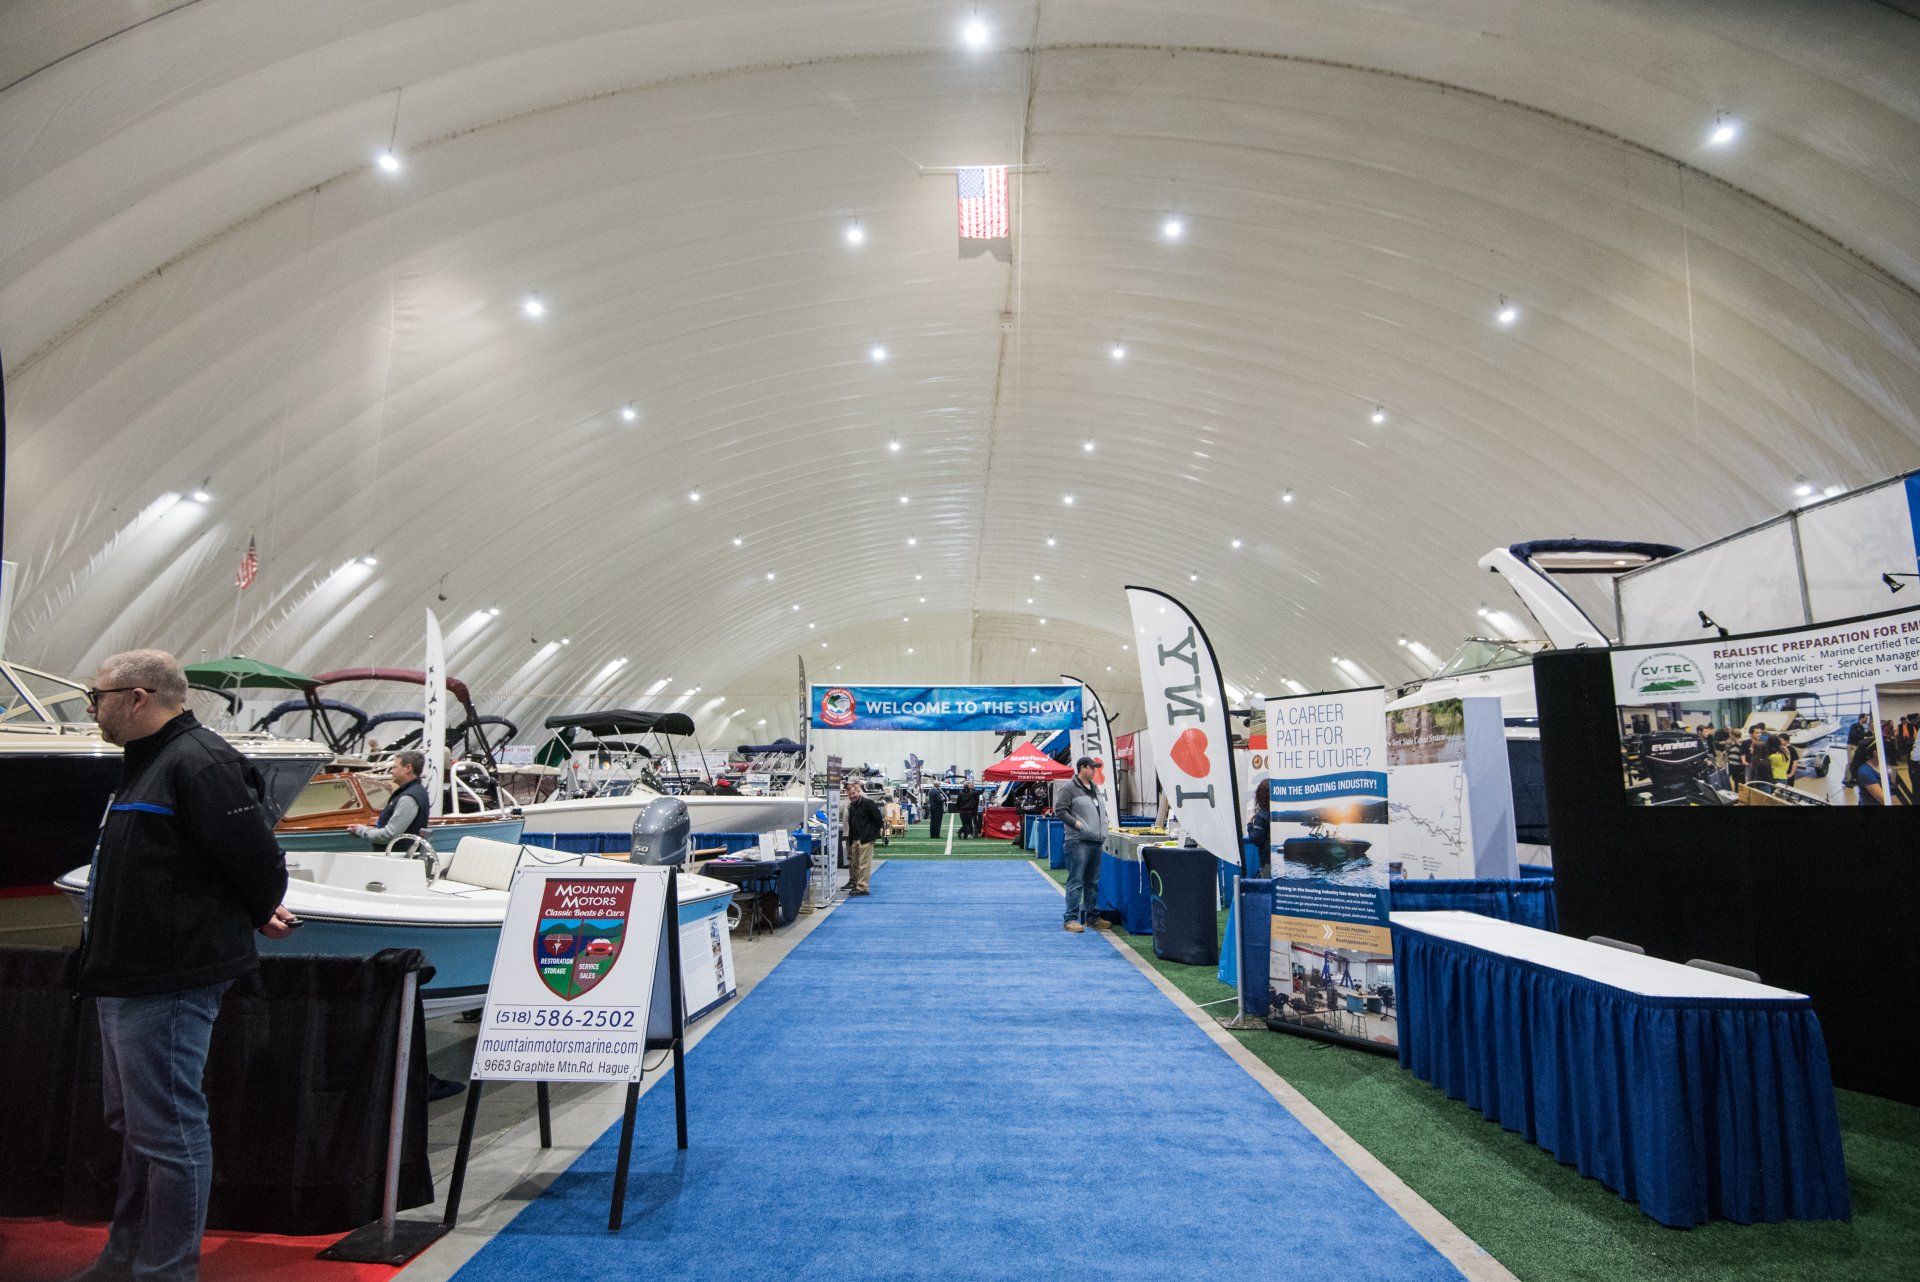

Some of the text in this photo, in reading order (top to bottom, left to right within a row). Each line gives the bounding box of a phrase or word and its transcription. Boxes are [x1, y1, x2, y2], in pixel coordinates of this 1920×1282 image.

[1713, 621, 1920, 659] REALISTIC PREPARATION FOR EM
[1714, 658, 1752, 670] Marine
[1755, 653, 1805, 667] Mechanic
[1820, 647, 1855, 658] Marine
[1858, 638, 1901, 653] Certified
[1641, 664, 1691, 675] CV-TEC
[1716, 669, 1753, 682] Service
[1756, 666, 1787, 678] Order
[1789, 663, 1823, 676] Writer
[1838, 658, 1873, 669] Service
[1876, 649, 1920, 661] Manager
[1716, 679, 1758, 692] Gelcoat
[1760, 677, 1769, 688] &
[1772, 673, 1824, 688] Fiberglass
[1827, 668, 1880, 681] Technician
[1894, 662, 1918, 672] Yard
[866, 700, 1075, 715] WELCOME TO THE SHOW!
[1276, 703, 1344, 725] A CAREER
[1276, 726, 1343, 747] PATH FOR
[1651, 741, 1698, 752] EVINRUDE
[1276, 746, 1371, 769] THE FUTURE?
[1272, 778, 1377, 796] JOIN THE BOATING INDUSTRY!
[554, 884, 624, 897] MOUNTAIN
[561, 896, 616, 909] MOTORS
[545, 908, 572, 917] Classic
[573, 908, 597, 917] Boats
[606, 908, 626, 917] Cars
[544, 967, 567, 975] STORAGE
[496, 1010, 635, 1028] (518) 586-2502
[482, 1038, 638, 1055] mountainmotorsmarine.com
[484, 1059, 511, 1072] 9663
[513, 1059, 555, 1074] Graphite
[598, 1061, 629, 1076] Hague
